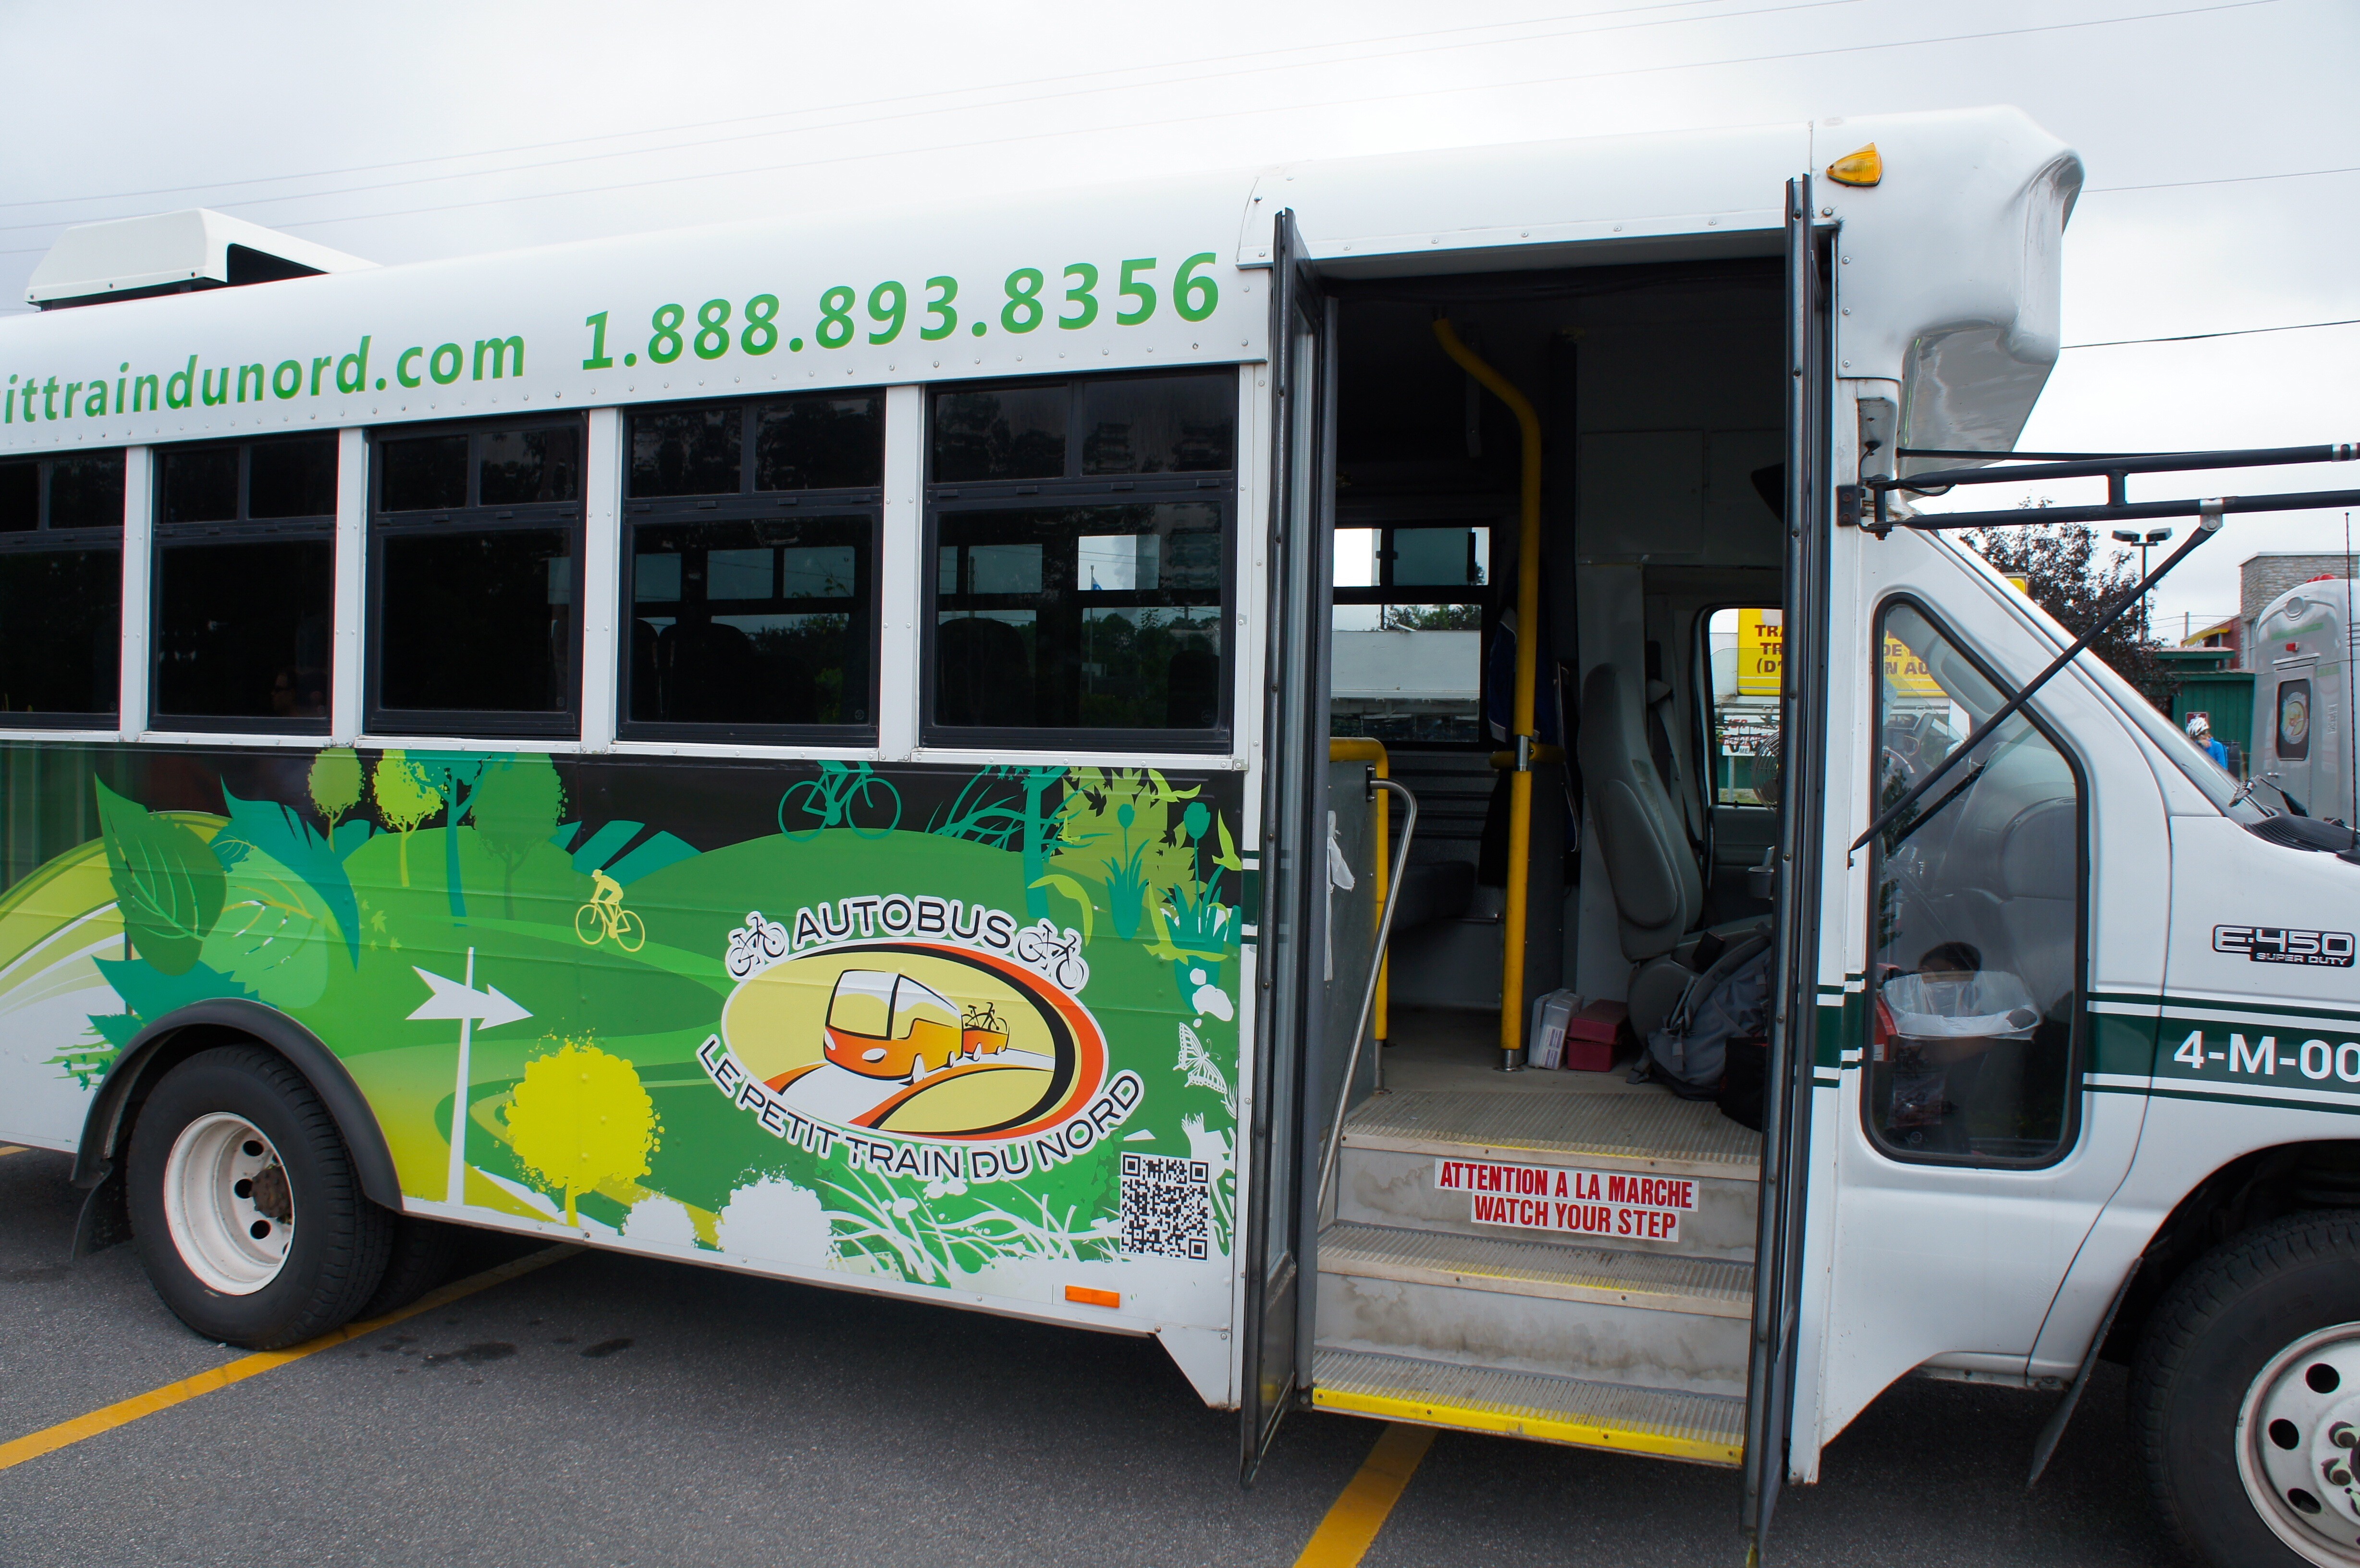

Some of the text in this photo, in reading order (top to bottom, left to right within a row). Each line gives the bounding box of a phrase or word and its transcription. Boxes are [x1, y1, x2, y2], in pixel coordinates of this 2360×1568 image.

[583, 253, 1219, 370] 1.888.893.8356
[796, 899, 1012, 950] AUTOBUS
[2256, 952, 2348, 966] SUPER DUTY
[700, 1039, 1140, 1178] LE PETIT TRAIN DU NORD
[1440, 1161, 1692, 1208] ATTENTION A LA MARCHE
[1475, 1195, 1676, 1238] WATCH YOUR STEP
